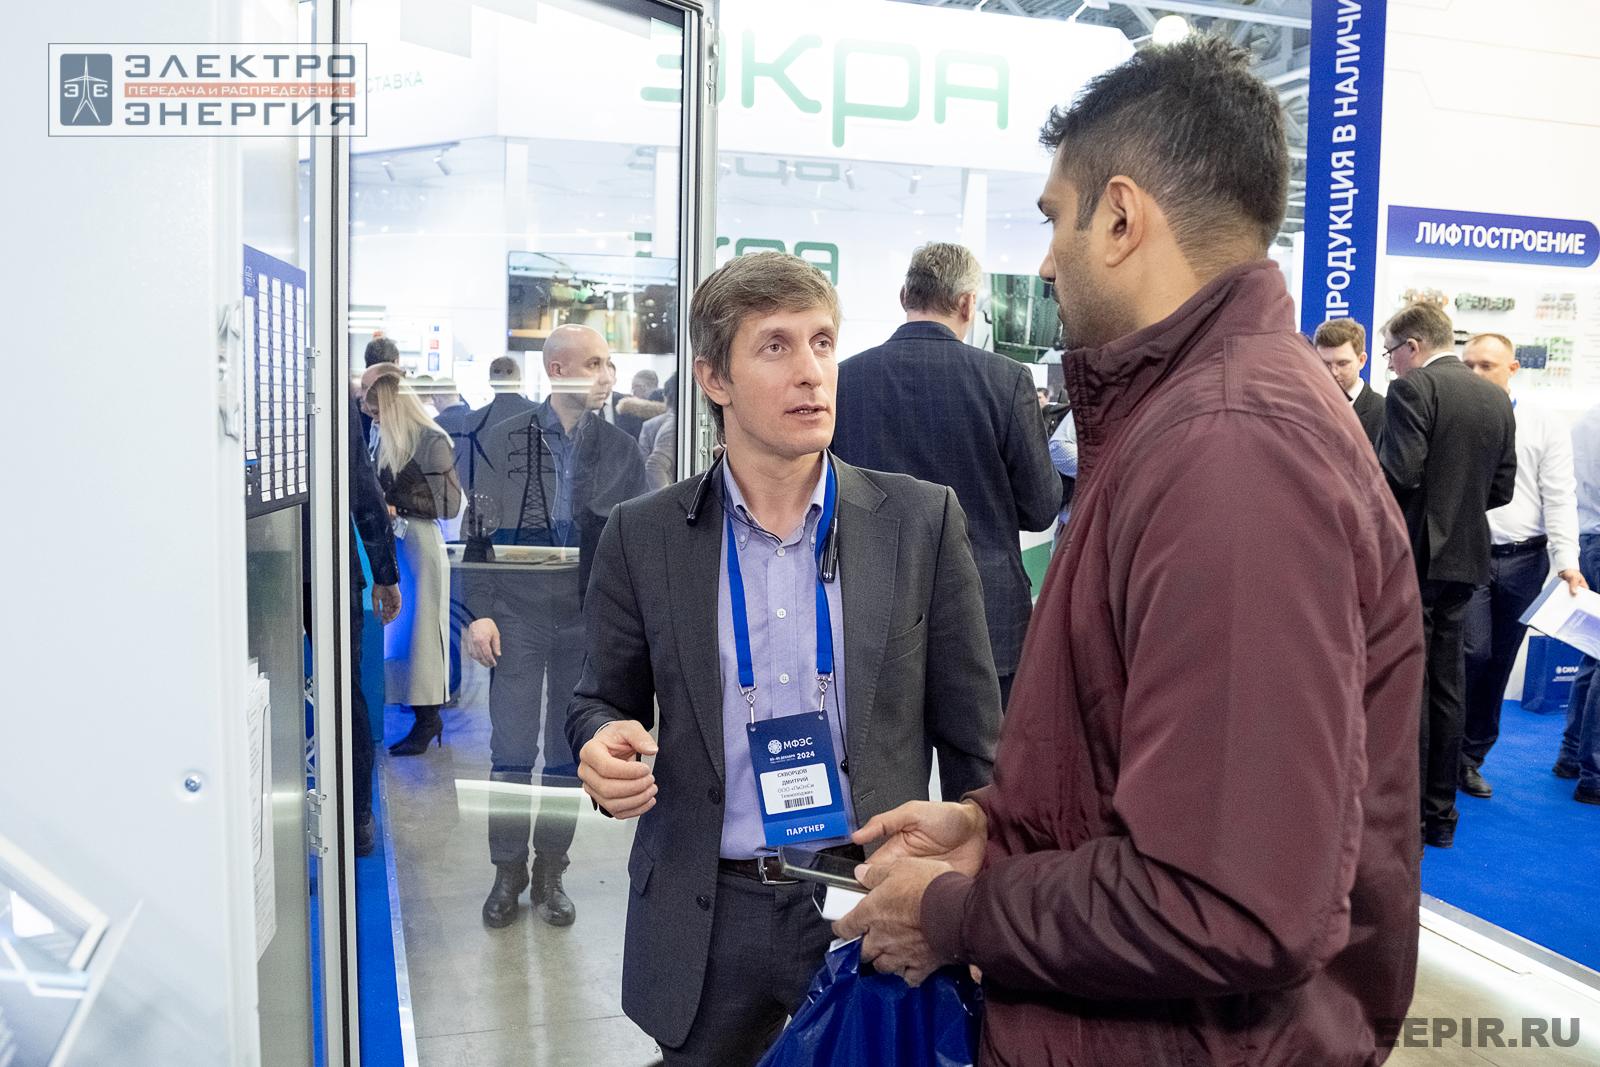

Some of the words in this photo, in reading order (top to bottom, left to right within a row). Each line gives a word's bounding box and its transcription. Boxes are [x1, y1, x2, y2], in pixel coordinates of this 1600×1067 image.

[1332, 124, 1357, 144] В
[1325, 150, 1359, 321] ПРОДУКЦИЯ
[1415, 221, 1586, 255] ЛИФТОСТРОЕНИЕ
[783, 736, 813, 750] МФЭС
[796, 750, 816, 760] 2024
[786, 823, 825, 836] ПАРТНЕР
